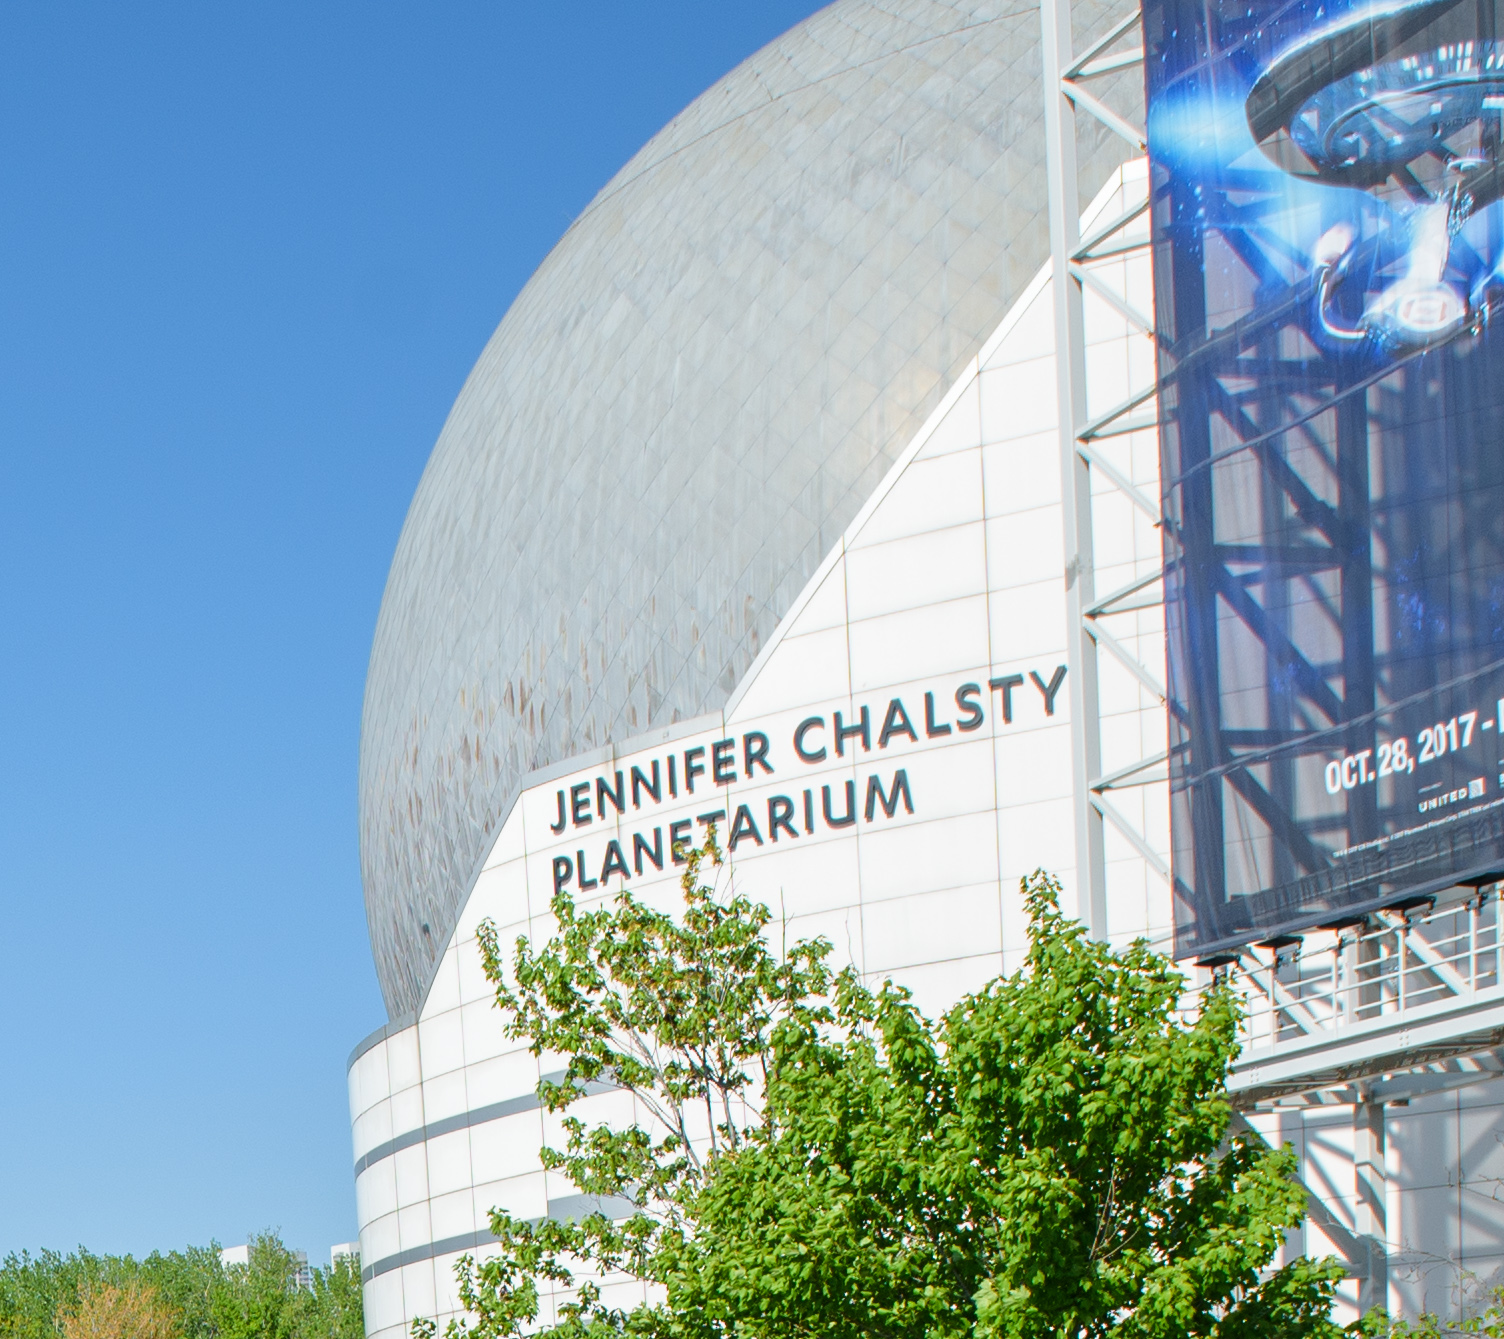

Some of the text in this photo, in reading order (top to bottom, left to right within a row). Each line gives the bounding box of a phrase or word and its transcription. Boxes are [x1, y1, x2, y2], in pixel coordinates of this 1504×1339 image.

[549, 664, 1069, 834] JENNIFER CHALSTY
[1325, 749, 1376, 795] OCT.
[1376, 736, 1415, 778] 28,
[1417, 711, 1478, 765] 2017
[1418, 787, 1468, 813] UNITED
[552, 769, 915, 895] PLANETARIUM
